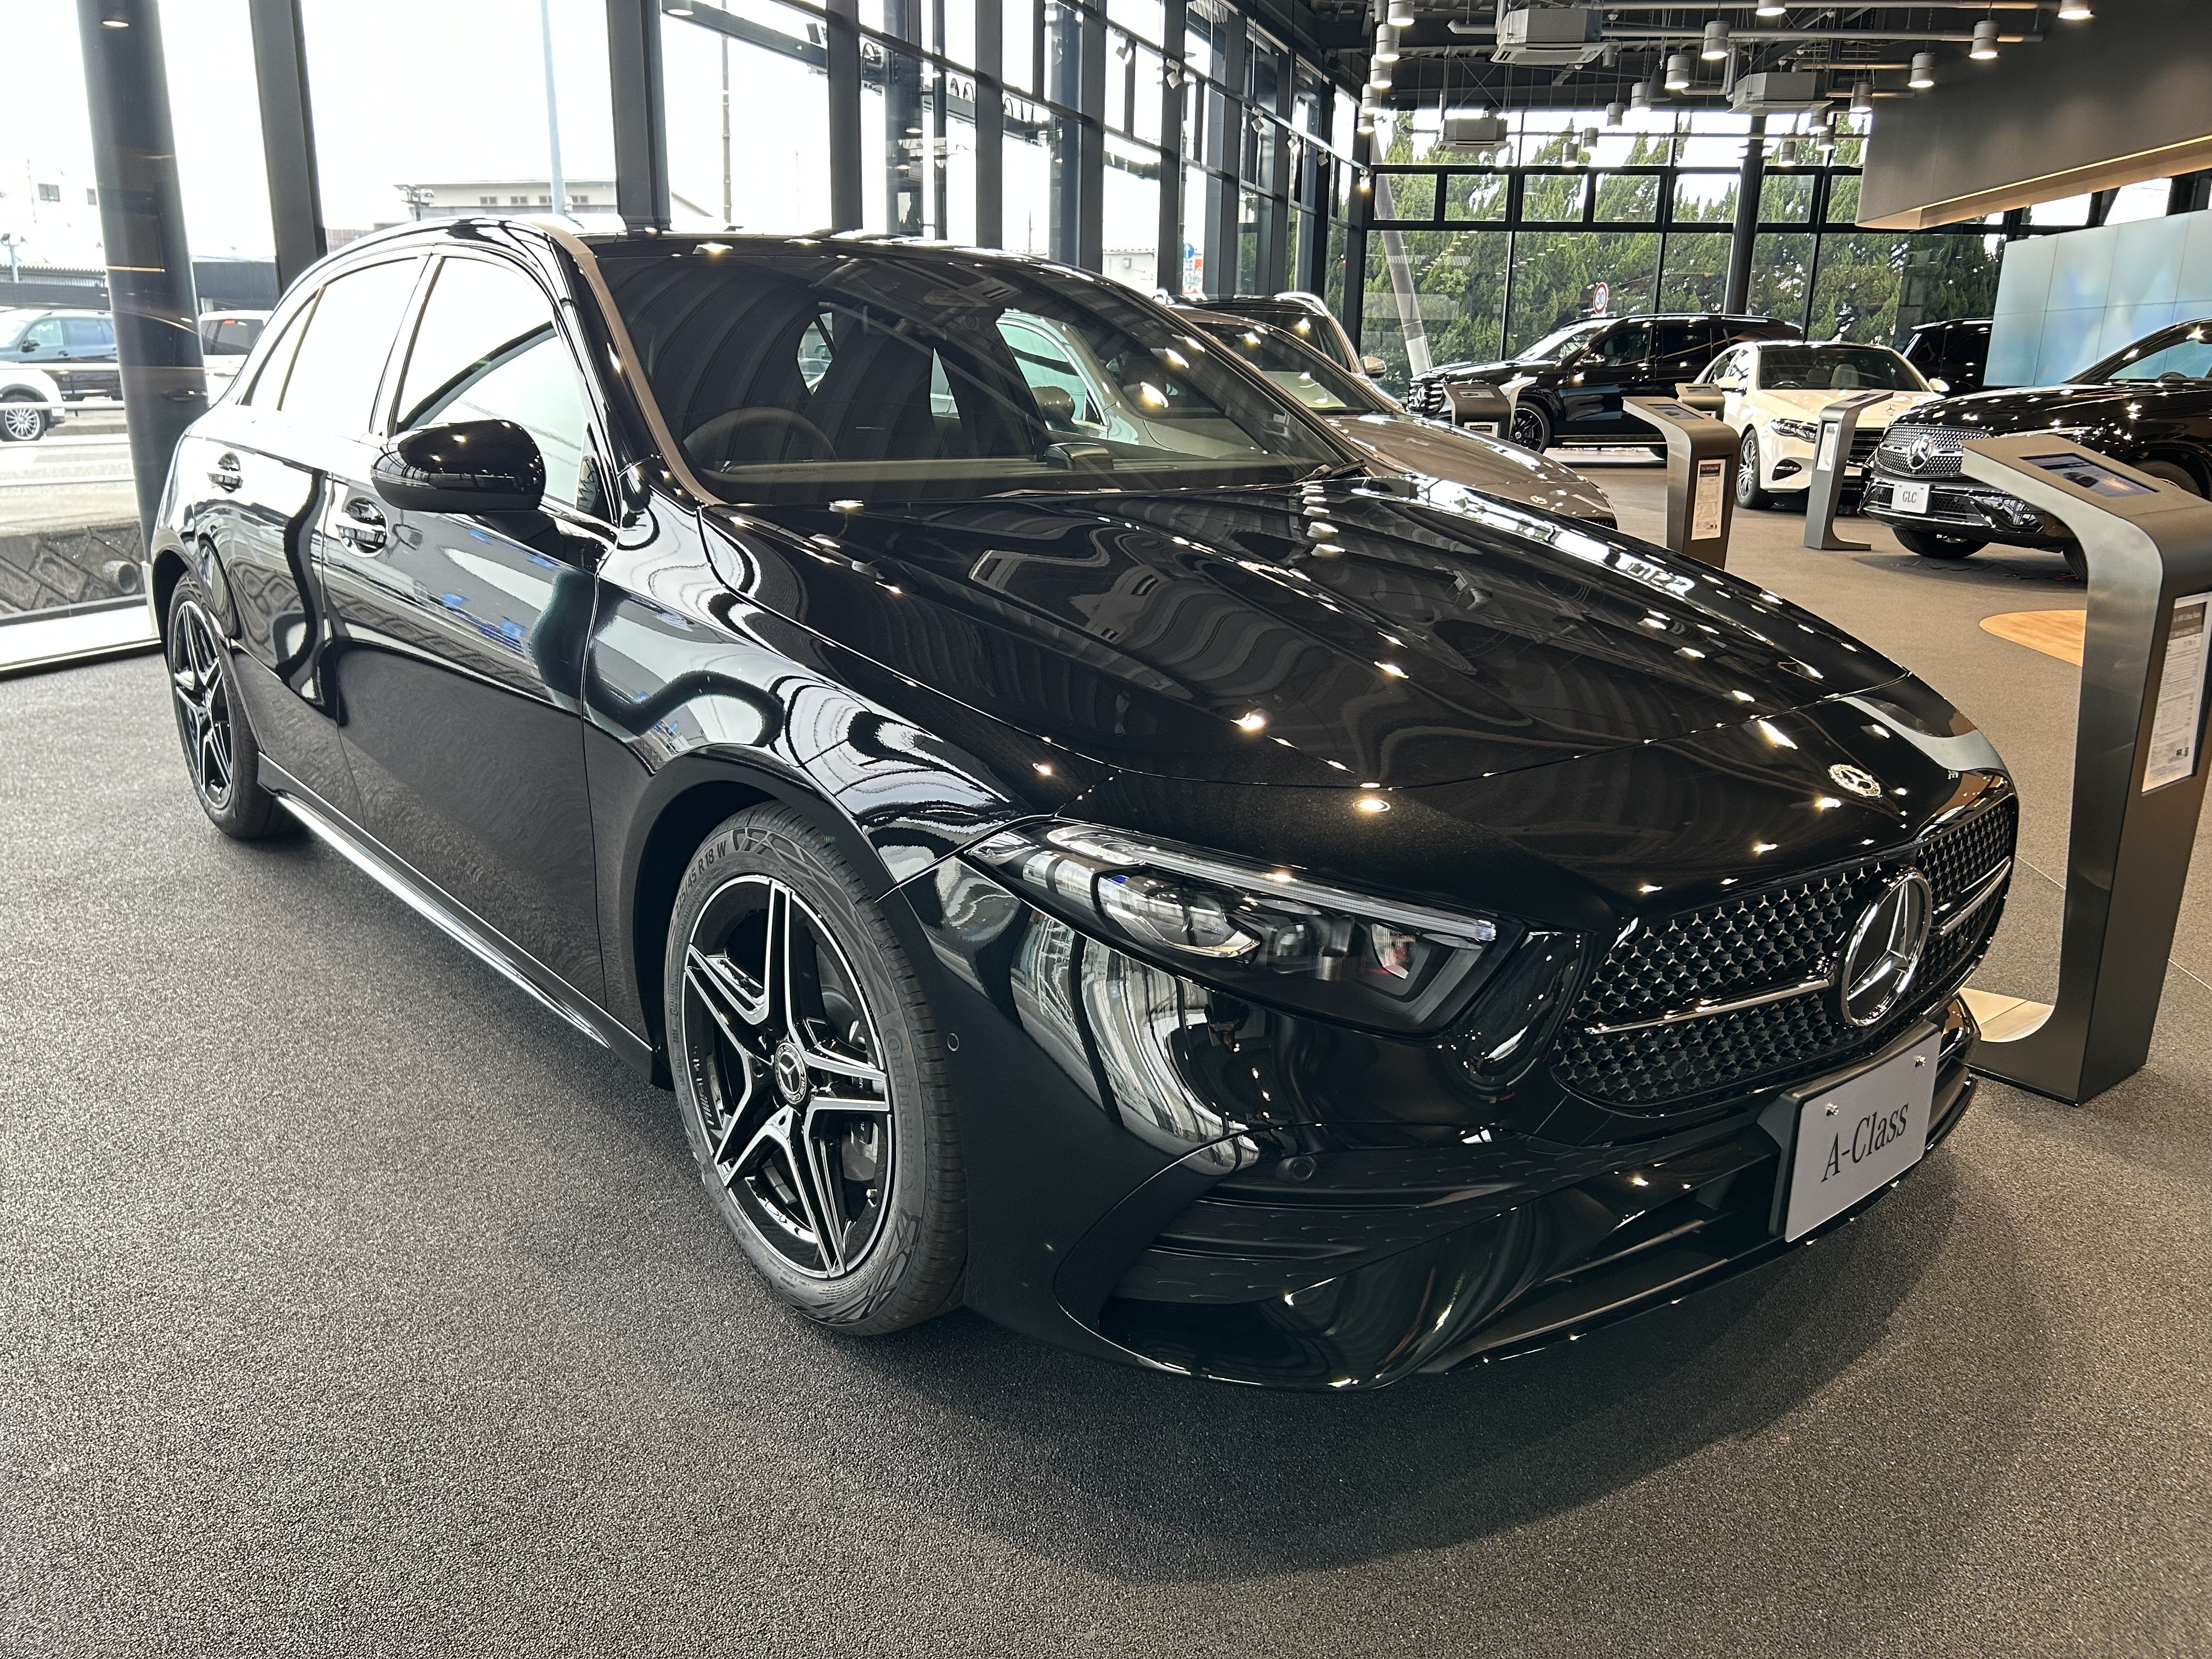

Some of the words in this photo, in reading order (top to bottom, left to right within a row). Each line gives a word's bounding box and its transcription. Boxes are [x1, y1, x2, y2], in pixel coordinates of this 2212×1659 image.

[1596, 292, 1605, 306] 30
[1903, 490, 1917, 503] GLC
[675, 867, 696, 918] 225/45
[716, 840, 727, 859] W
[1820, 1103, 1910, 1183] A-Class
